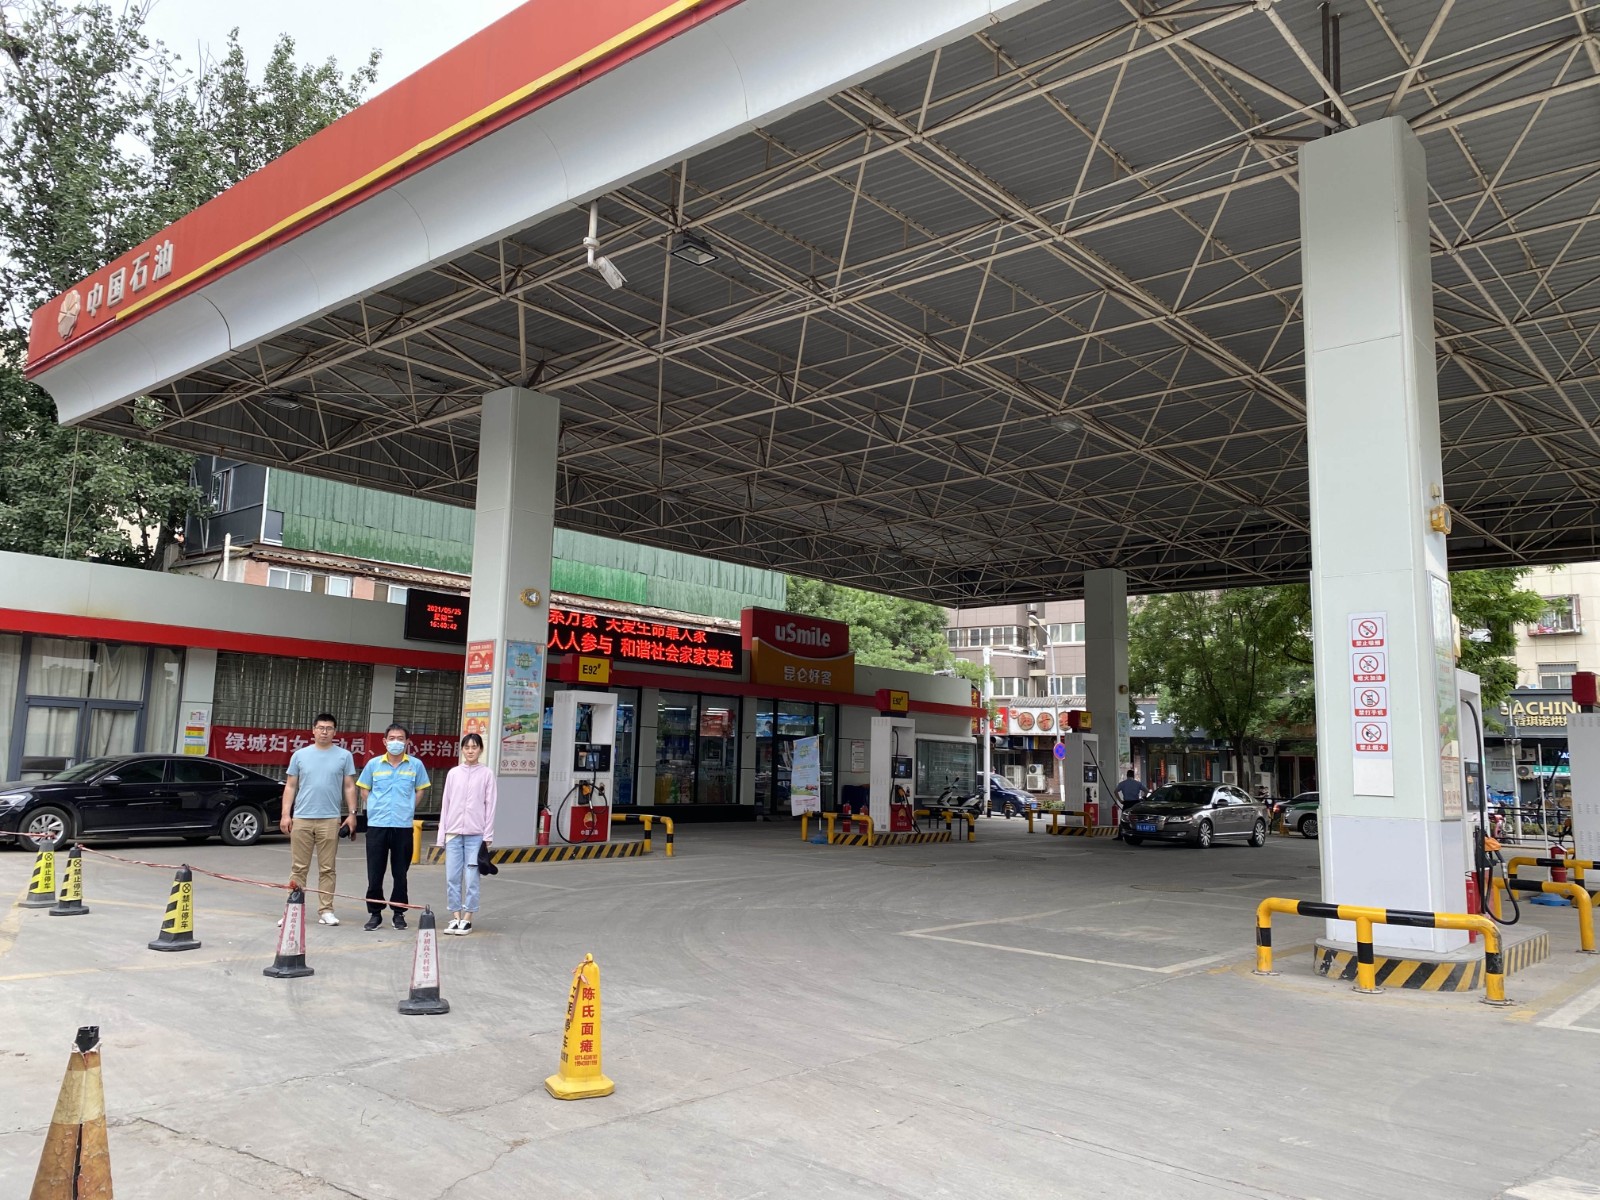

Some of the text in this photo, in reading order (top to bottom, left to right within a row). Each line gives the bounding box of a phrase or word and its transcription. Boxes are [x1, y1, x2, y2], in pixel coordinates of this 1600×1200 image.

[86, 239, 174, 318] 中国石油
[427, 604, 462, 615] 2021/05/25
[547, 629, 734, 669] 人人参与 和谐社会家家受益
[775, 622, 831, 647] uSmile
[784, 665, 832, 685] 昆仑好客
[44, 862, 52, 889] 禁止停车
[73, 868, 81, 897] 禁止停车
[181, 894, 190, 929] 禁止停车
[579, 987, 596, 1053] 陈氏面瘫
